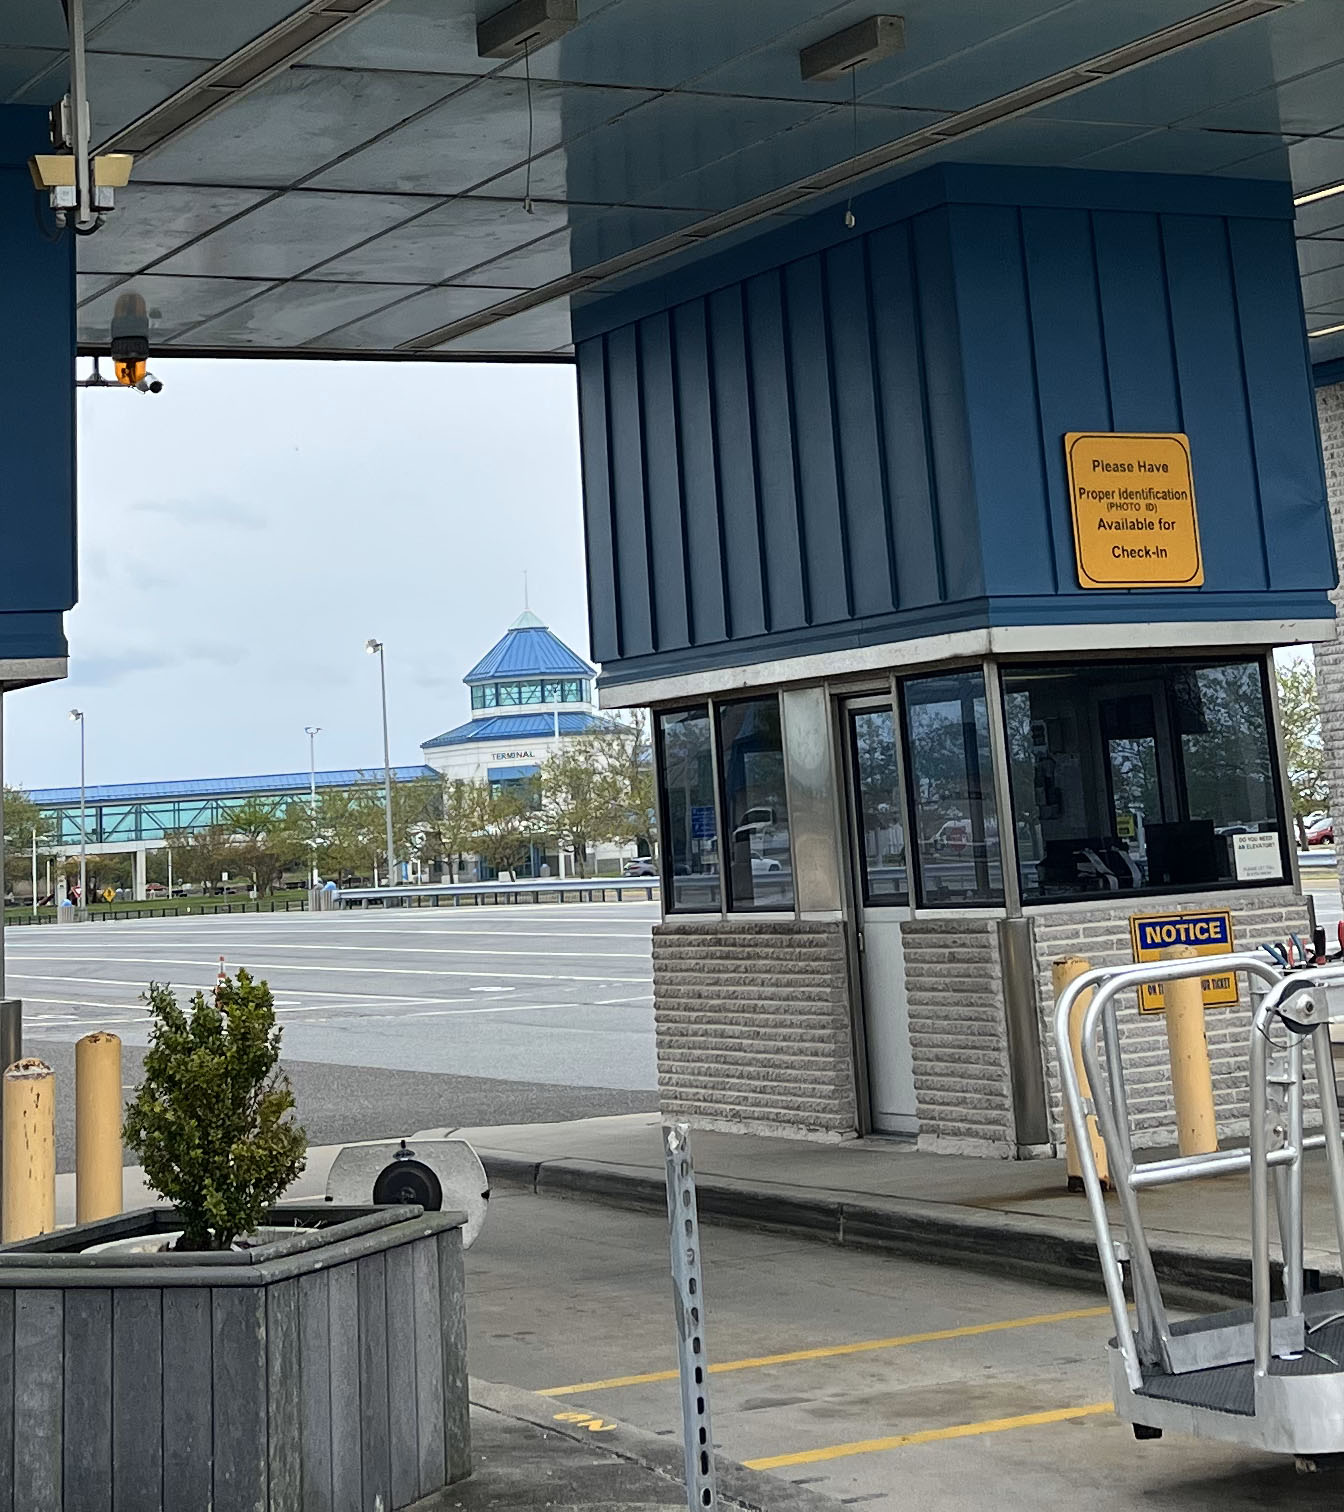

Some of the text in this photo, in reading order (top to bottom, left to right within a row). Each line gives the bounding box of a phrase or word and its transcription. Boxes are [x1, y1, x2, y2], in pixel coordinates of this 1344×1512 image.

[1092, 459, 1169, 473] Please Have
[1078, 487, 1188, 503] Proper Identification
[1106, 502, 1158, 514] (PHOTO ID)
[1097, 517, 1176, 531] Available for
[1111, 545, 1168, 559] Check-In
[491, 751, 536, 761] TERMINAL
[1145, 921, 1222, 944] NOTICE
